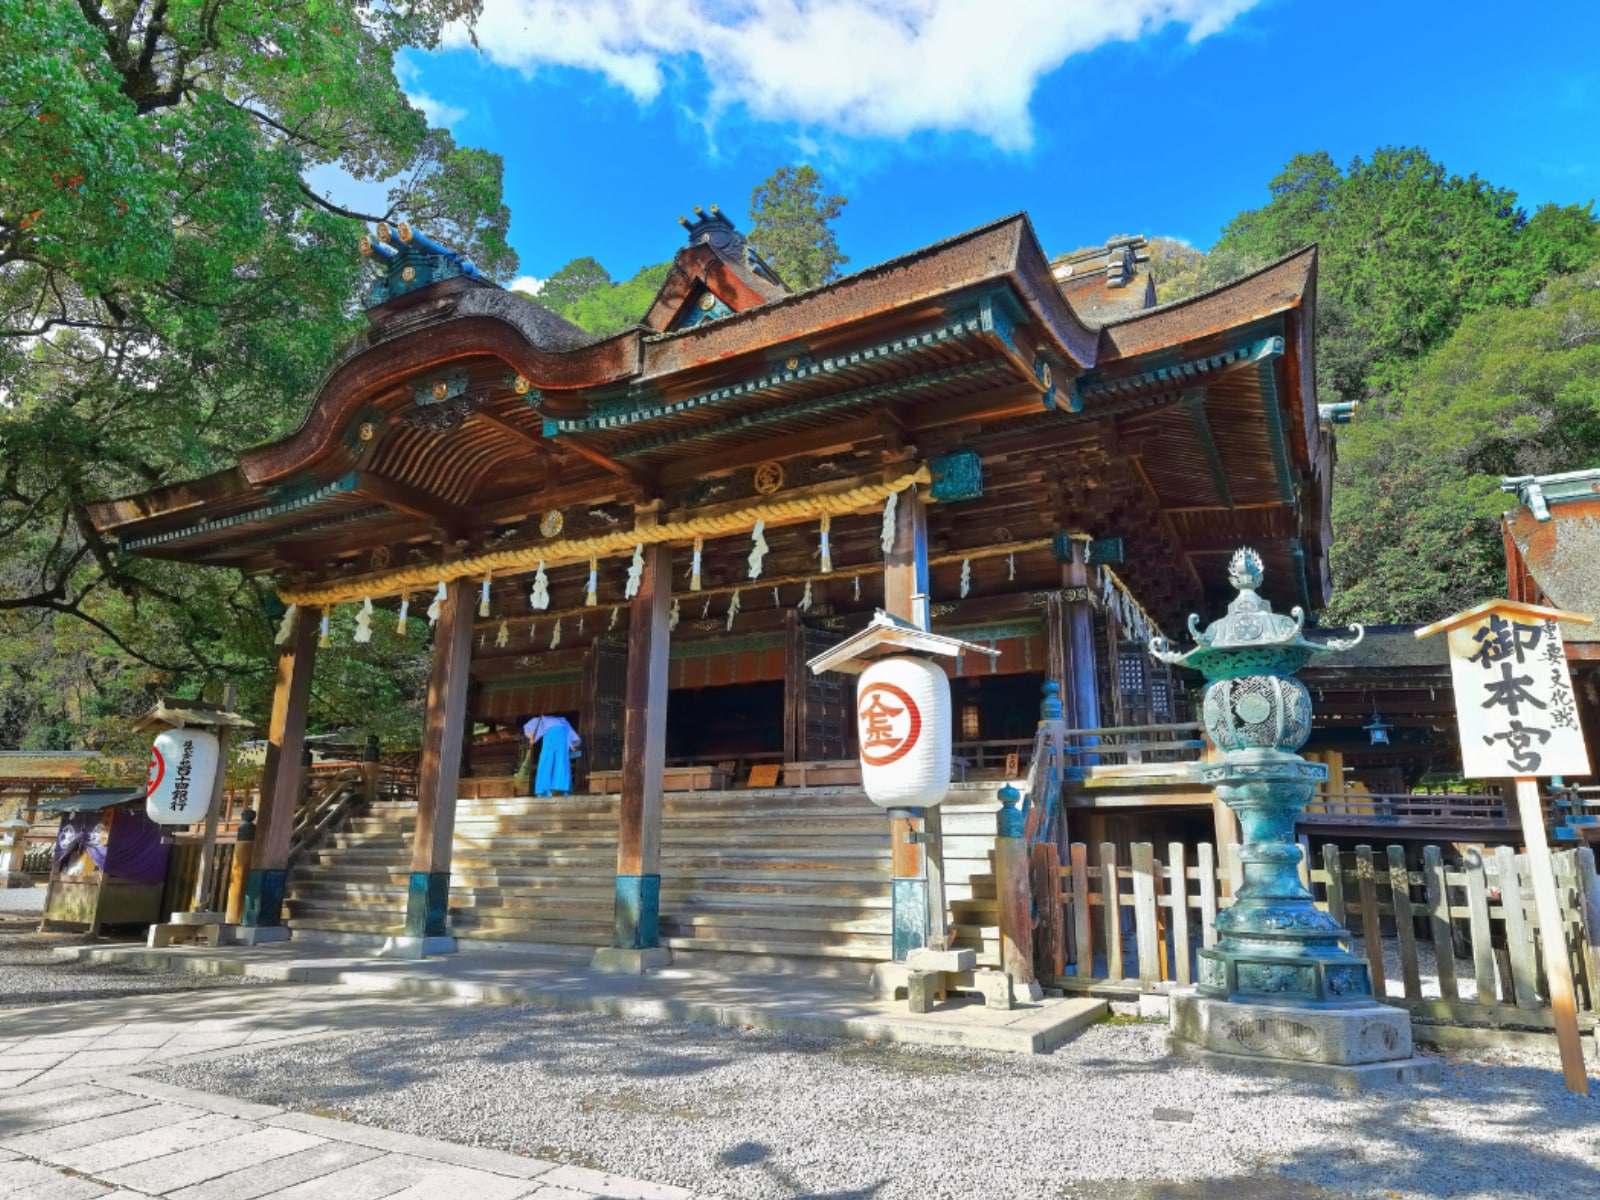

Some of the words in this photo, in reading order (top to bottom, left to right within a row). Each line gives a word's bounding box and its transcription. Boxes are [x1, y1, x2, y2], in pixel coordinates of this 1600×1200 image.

[860, 694, 905, 750] 金
[1467, 613, 1551, 773] 御本宮
